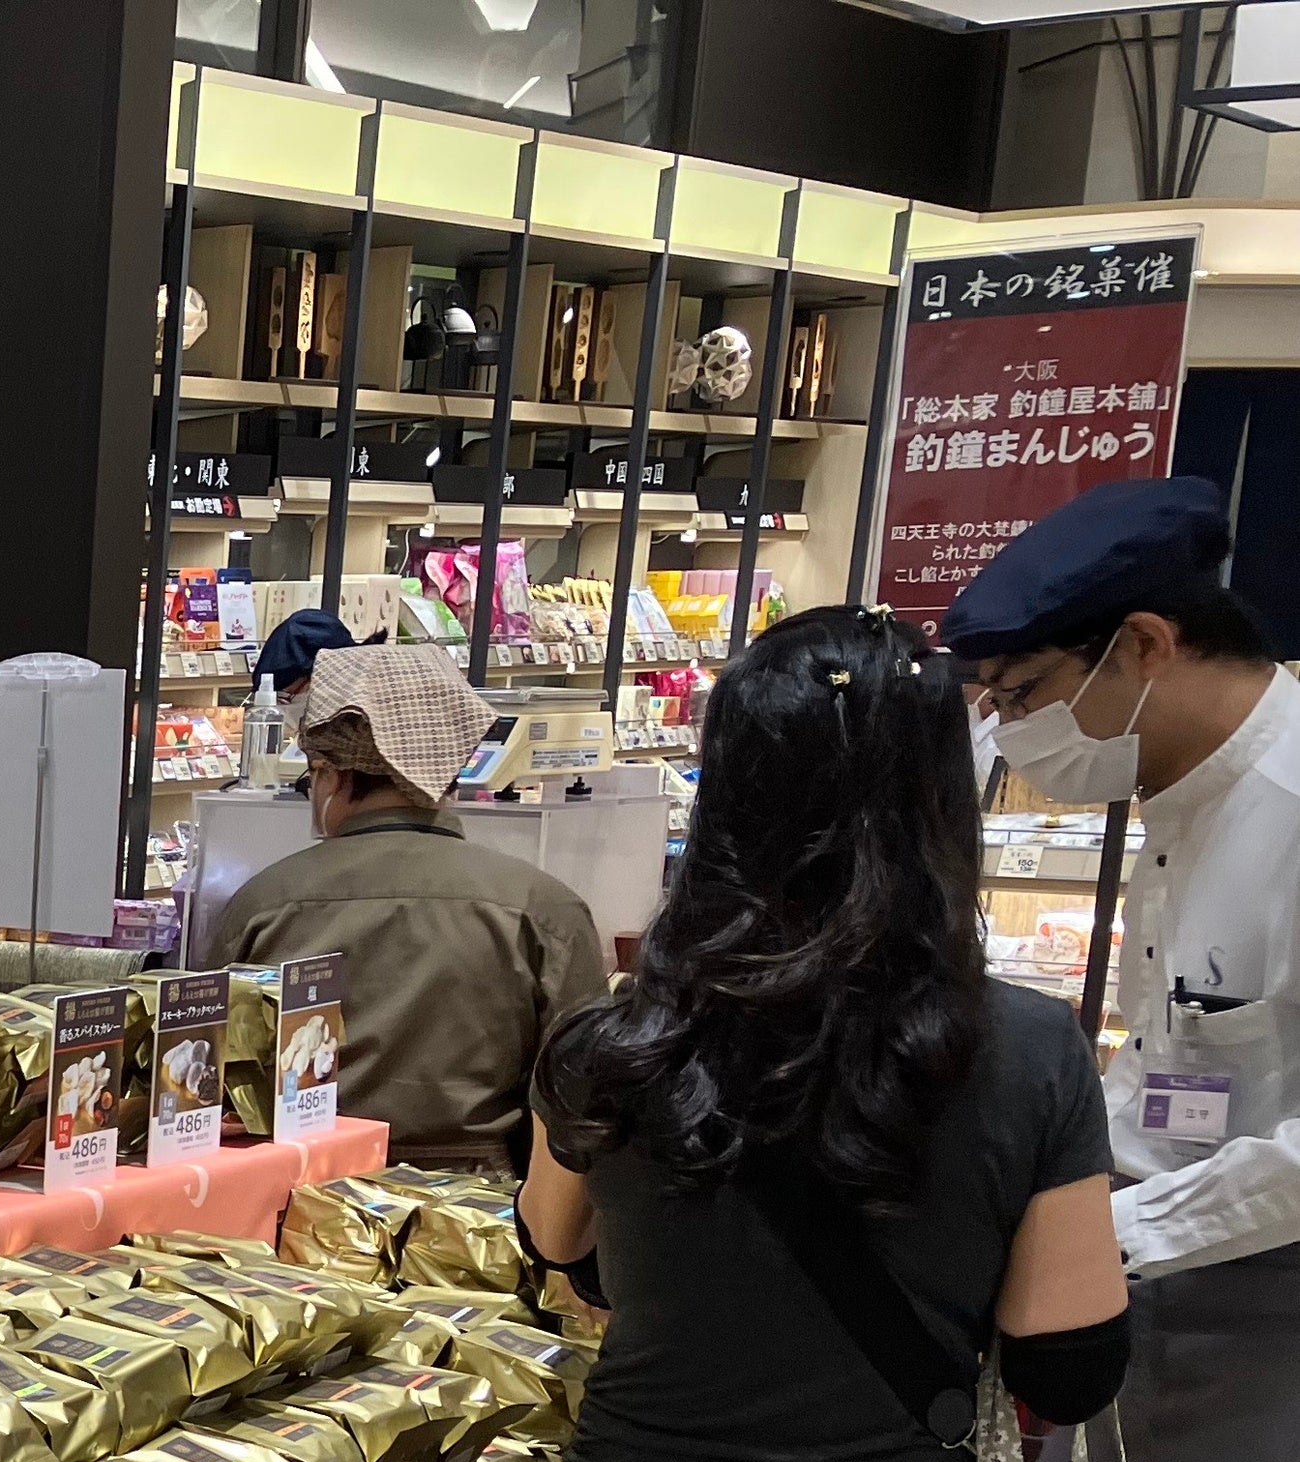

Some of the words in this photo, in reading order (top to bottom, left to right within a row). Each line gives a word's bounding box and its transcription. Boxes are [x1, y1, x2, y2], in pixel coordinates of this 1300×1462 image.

[922, 252, 1176, 309] 日本の銘菓催
[1014, 357, 1060, 382] 大阪
[905, 421, 1155, 474] 釣鐘まんじゅう
[891, 520, 1032, 542] 四天王寺の大梵鐘
[931, 541, 1007, 561] られた釣
[59, 1023, 121, 1044] 香るスパイスカレー
